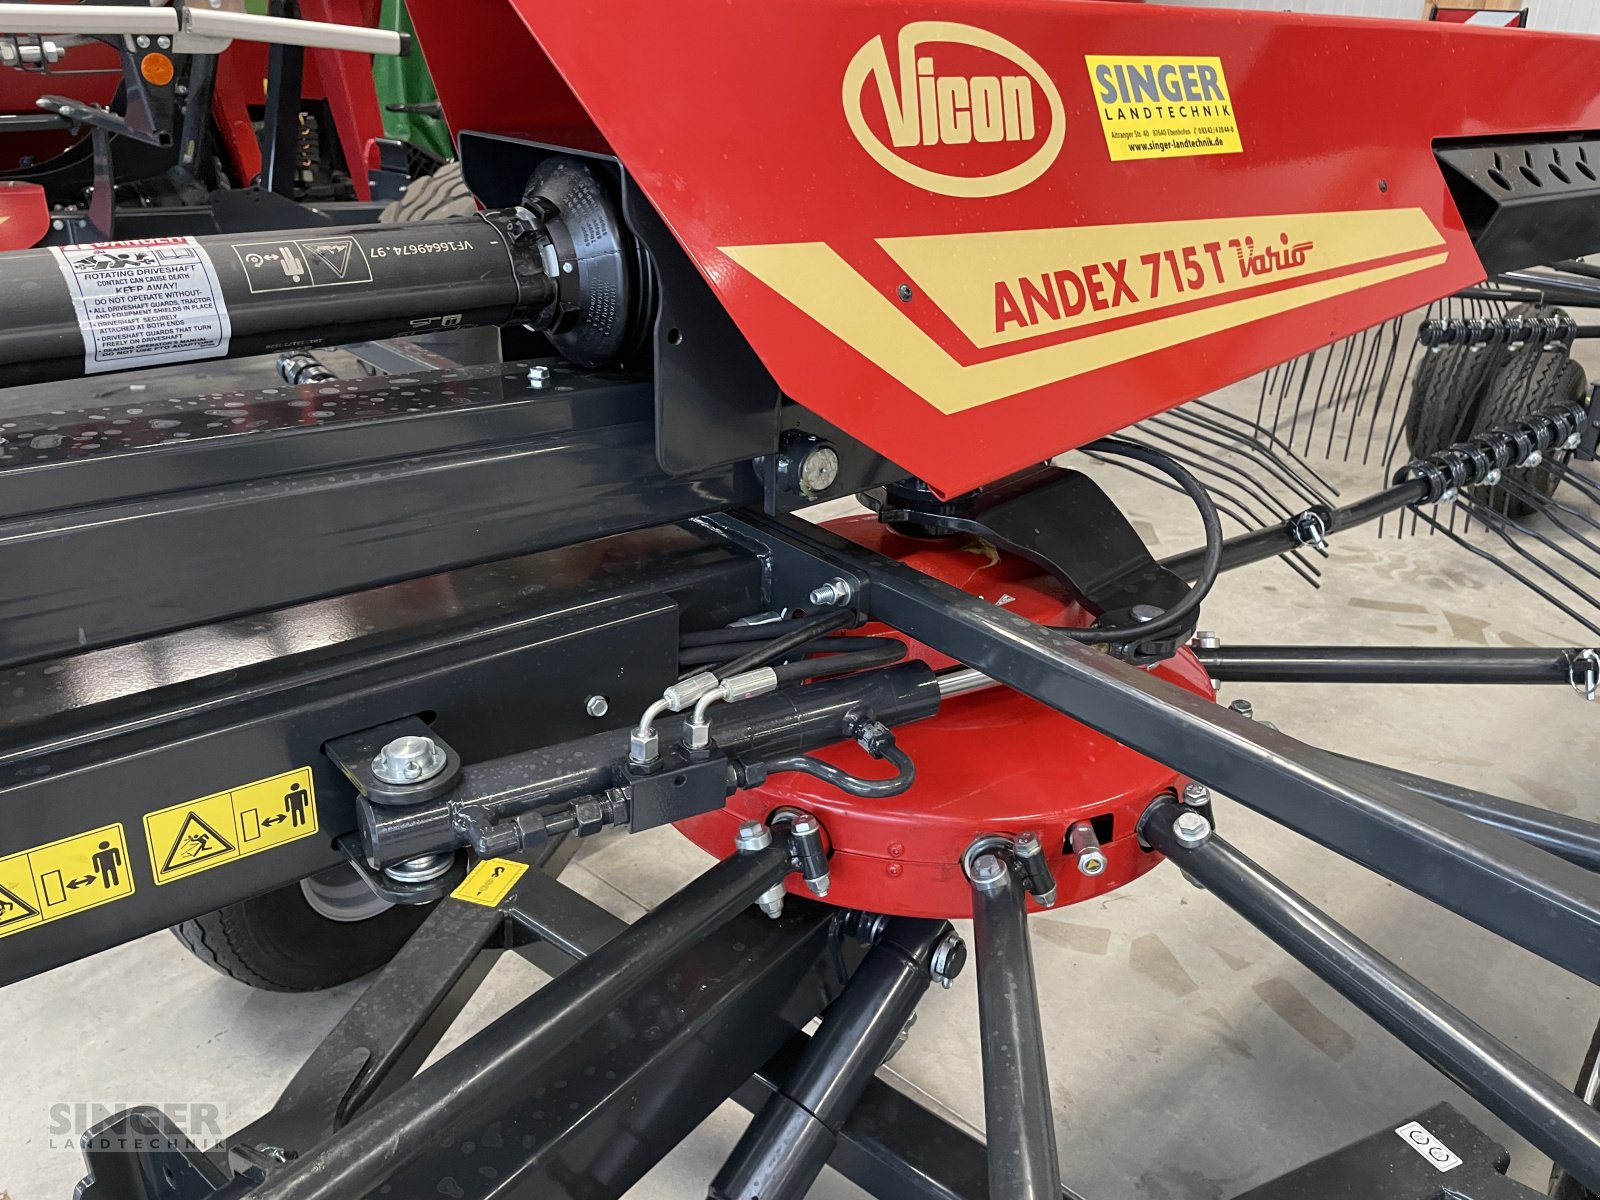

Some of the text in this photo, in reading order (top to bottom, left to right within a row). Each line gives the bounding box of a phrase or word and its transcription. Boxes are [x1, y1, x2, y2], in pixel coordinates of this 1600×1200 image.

[862, 24, 1038, 148] Vicon
[1096, 64, 1225, 104] SINGER
[1104, 105, 1231, 121] LANDTECHNIK
[1128, 137, 1223, 152] www.singer-landtechnik.de
[370, 240, 474, 258] VF16649674.97
[84, 265, 196, 280] ROTATING DRIVESHAFT
[97, 278, 128, 286] CONTACT
[146, 275, 168, 283] CAUSE
[146, 282, 178, 291] AWAY!
[994, 232, 1314, 333] ANDEX 715 T Vario
[128, 293, 163, 302] OPERATE
[108, 303, 148, 312] DRIVESHAFT
[143, 314, 177, 322] SECURELY
[101, 332, 144, 341] DRIVESHAFT
[146, 328, 174, 336] GUARDS
[142, 334, 183, 343] DRIVESHAFT
